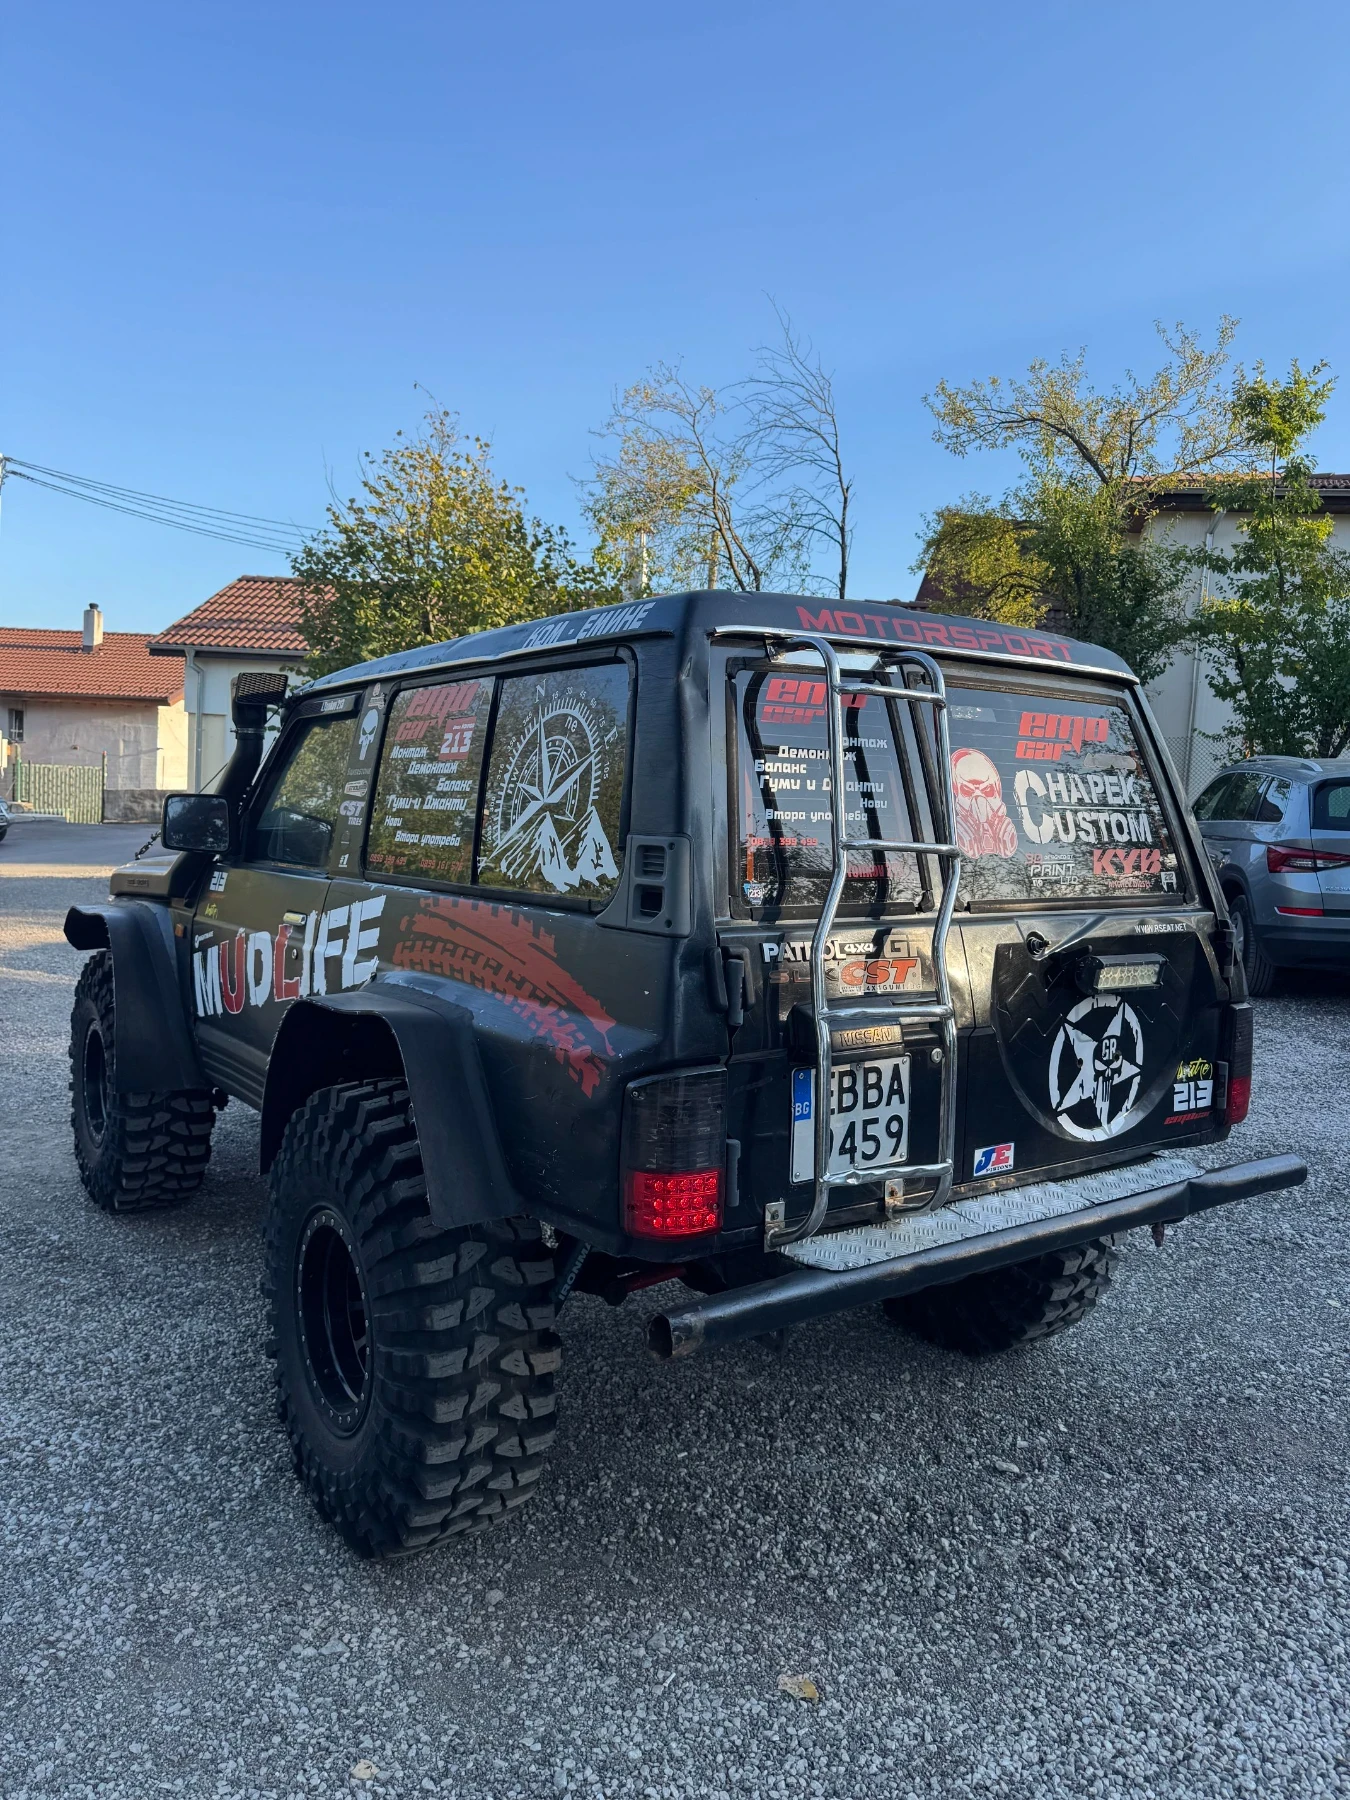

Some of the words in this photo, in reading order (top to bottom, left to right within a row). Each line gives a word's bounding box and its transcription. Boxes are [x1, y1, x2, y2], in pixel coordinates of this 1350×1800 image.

[796, 605, 1071, 662] MOTORSPORT
[535, 678, 547, 703] N
[551, 690, 559, 700] 15
[760, 705, 826, 724] car
[440, 730, 473, 754] 213
[840, 736, 888, 750] онтаж
[390, 745, 428, 759] Монтаж
[1015, 740, 1073, 761] car
[407, 761, 459, 775] Демонтаж
[754, 759, 807, 774] Баланс
[436, 777, 473, 792] Баланс
[760, 774, 800, 793] Гуми
[807, 780, 817, 791] и
[821, 777, 885, 793] Данти
[340, 800, 366, 818] CST
[423, 795, 468, 811] Джанти
[859, 798, 888, 809] Нови
[765, 808, 806, 823] Втора
[810, 811, 869, 823] упоеба
[395, 830, 420, 845] Втора
[421, 833, 461, 847] употреба
[779, 837, 797, 847] 399
[1093, 848, 1161, 875] KYB
[1030, 863, 1075, 877] PRINT
[841, 959, 917, 987] CST
[839, 1026, 892, 1047] NISSAN
[1173, 1079, 1214, 1112] 213
[794, 1101, 810, 1116] BG
[975, 1144, 1012, 1174] JE
[986, 1163, 1013, 1173] PISTONS
